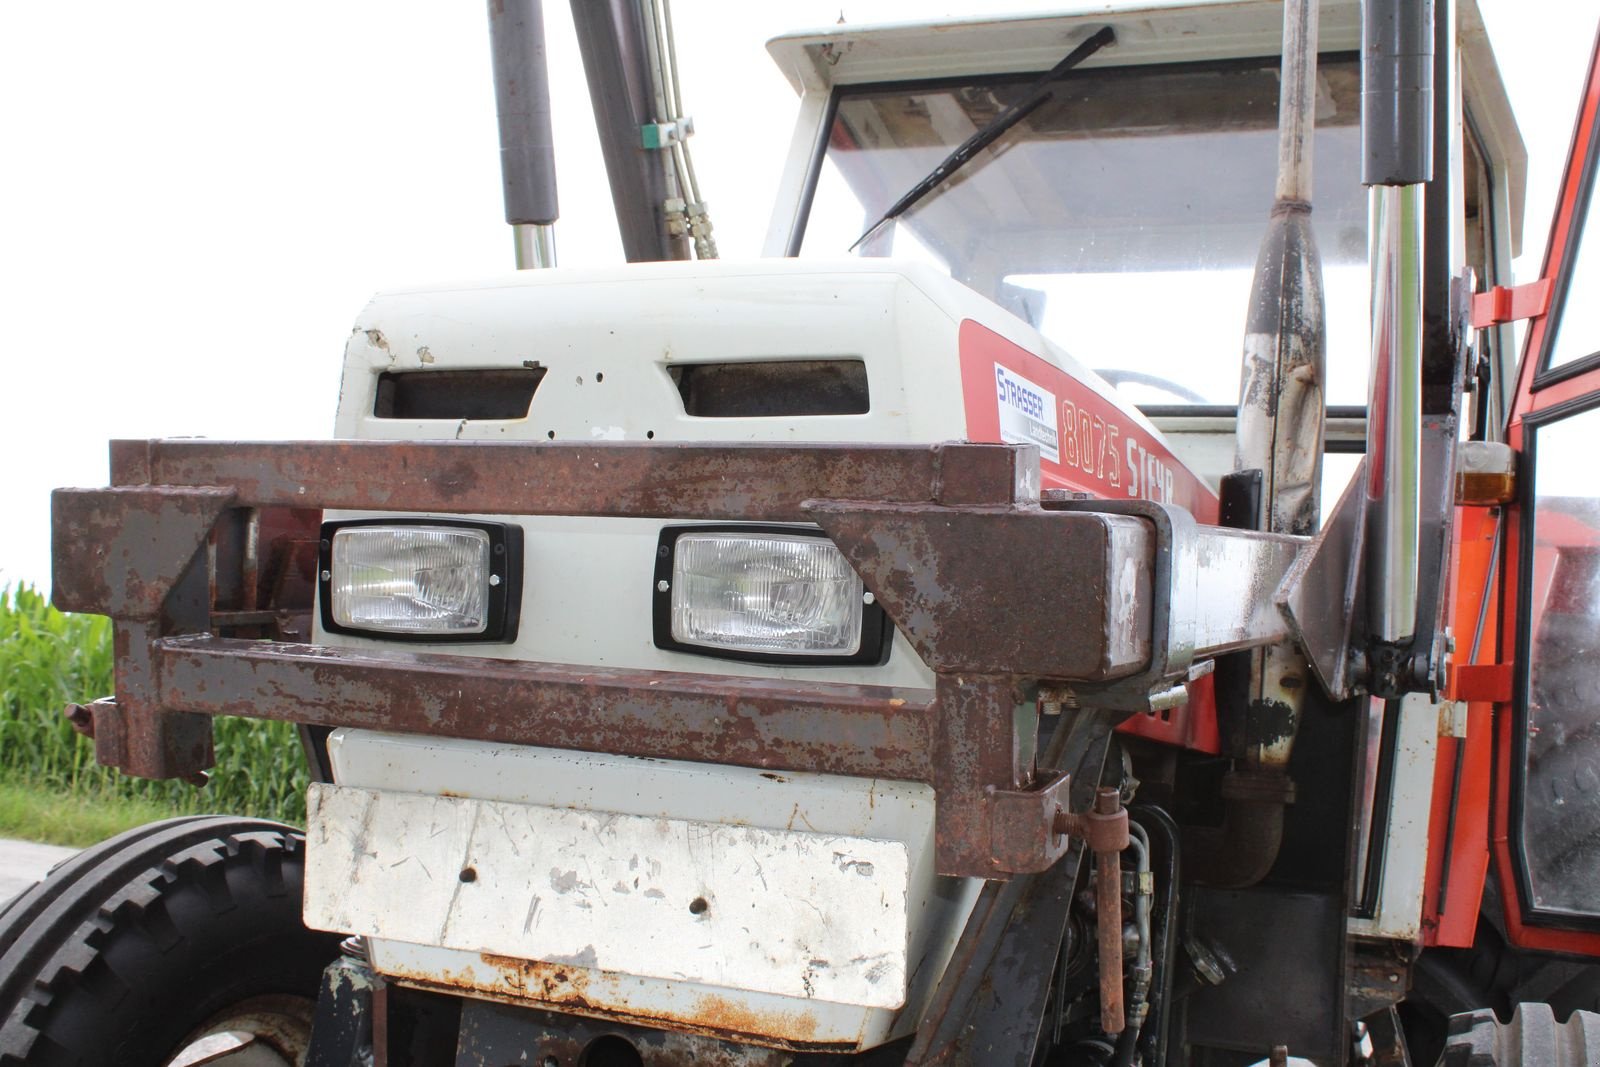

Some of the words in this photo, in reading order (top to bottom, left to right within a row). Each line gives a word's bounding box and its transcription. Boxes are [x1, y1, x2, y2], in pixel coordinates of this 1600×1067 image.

[998, 368, 1043, 420] STRASSER
[1063, 401, 1120, 487] 8075
[1127, 438, 1173, 504] STEYR
